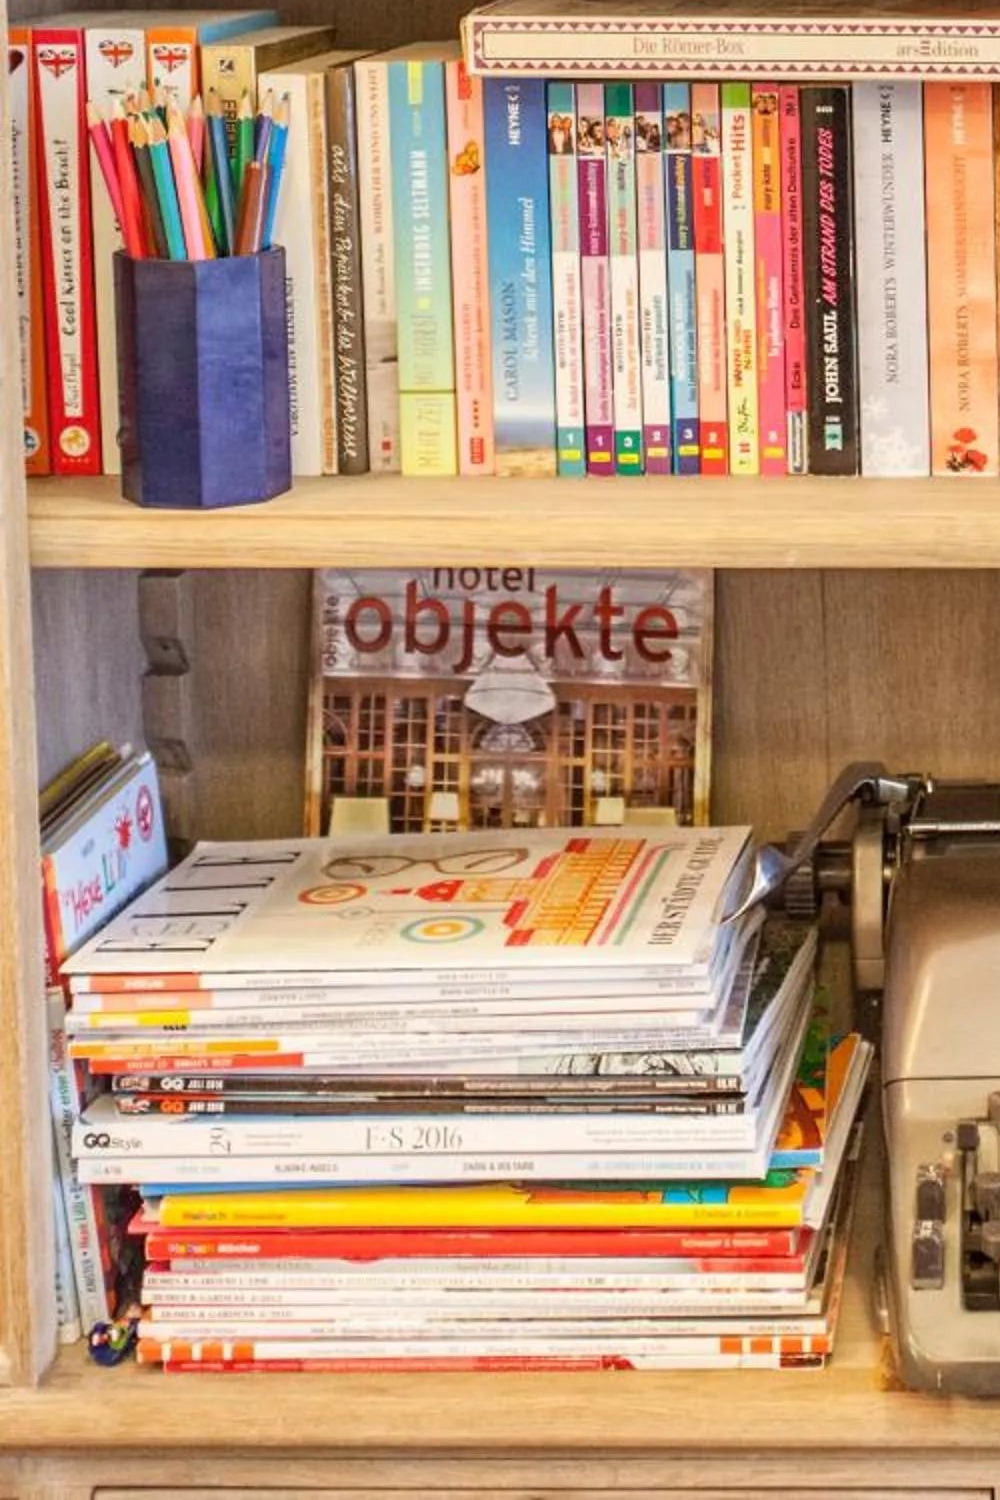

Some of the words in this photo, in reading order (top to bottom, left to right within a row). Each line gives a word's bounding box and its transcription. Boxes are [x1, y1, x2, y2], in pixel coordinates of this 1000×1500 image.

[633, 36, 659, 54] Die
[661, 36, 744, 56] Römer-Box
[506, 104, 520, 146] HEYNE
[728, 115, 746, 152] Hits
[879, 102, 893, 144] HEYNE
[810, 127, 833, 179] TODES
[57, 195, 72, 220] the
[813, 181, 835, 213] DES
[517, 196, 536, 254] Himmel
[815, 216, 837, 278] STRAND
[501, 282, 518, 343] MASON
[818, 281, 838, 306] AM
[882, 275, 899, 340] ROBERTS
[60, 300, 76, 337] Cool
[819, 310, 839, 353] SAUL
[955, 303, 971, 368] ROBERTS
[503, 347, 519, 402] CAROL
[821, 356, 842, 403] JOHN
[885, 342, 900, 385] NORA
[958, 369, 972, 413] NORA
[344, 578, 680, 674] objekte
[412, 1127, 464, 1149] 2016
